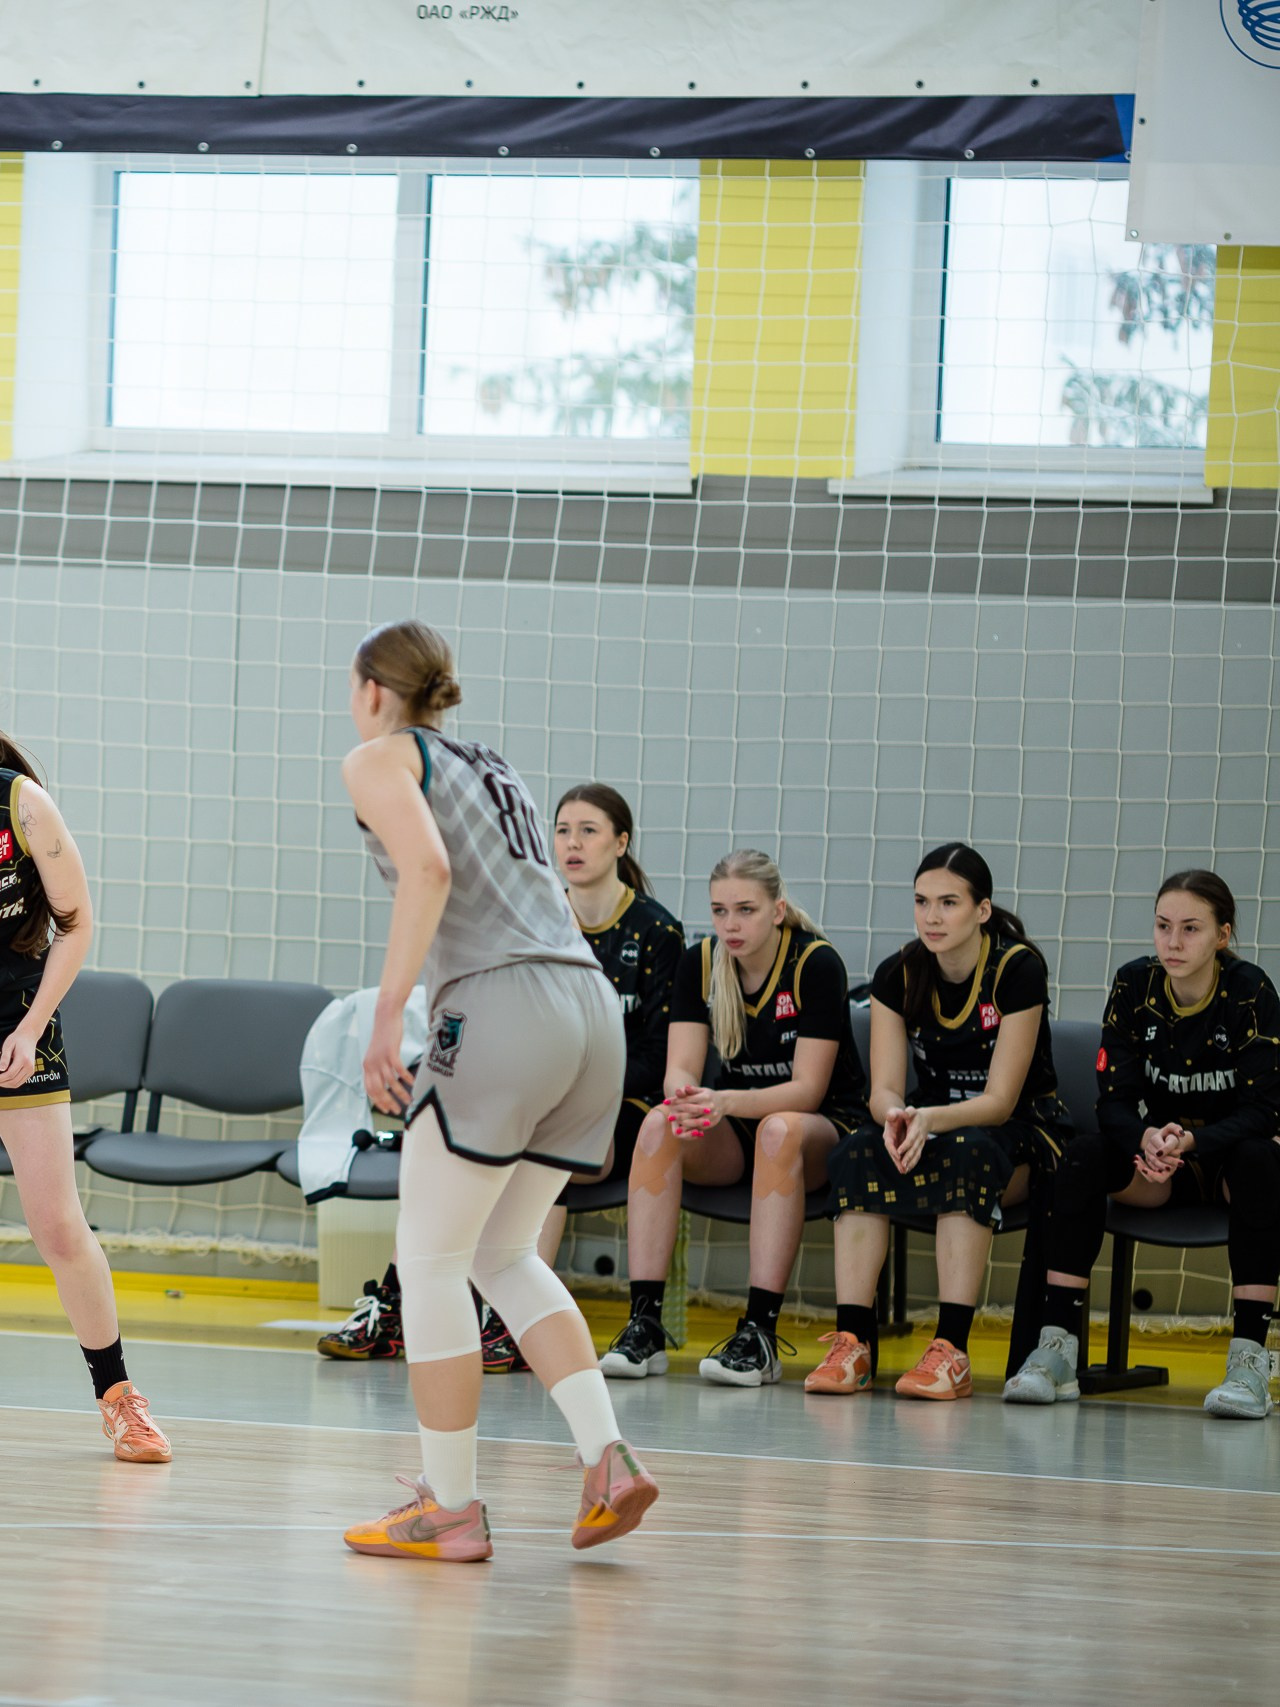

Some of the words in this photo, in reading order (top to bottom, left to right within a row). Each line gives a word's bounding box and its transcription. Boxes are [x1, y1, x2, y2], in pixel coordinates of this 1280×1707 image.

[417, 5, 452, 19] ОАО
[459, 5, 519, 21] «РЖД»
[982, 1006, 995, 1017] FO
[983, 1016, 999, 1028] BE
